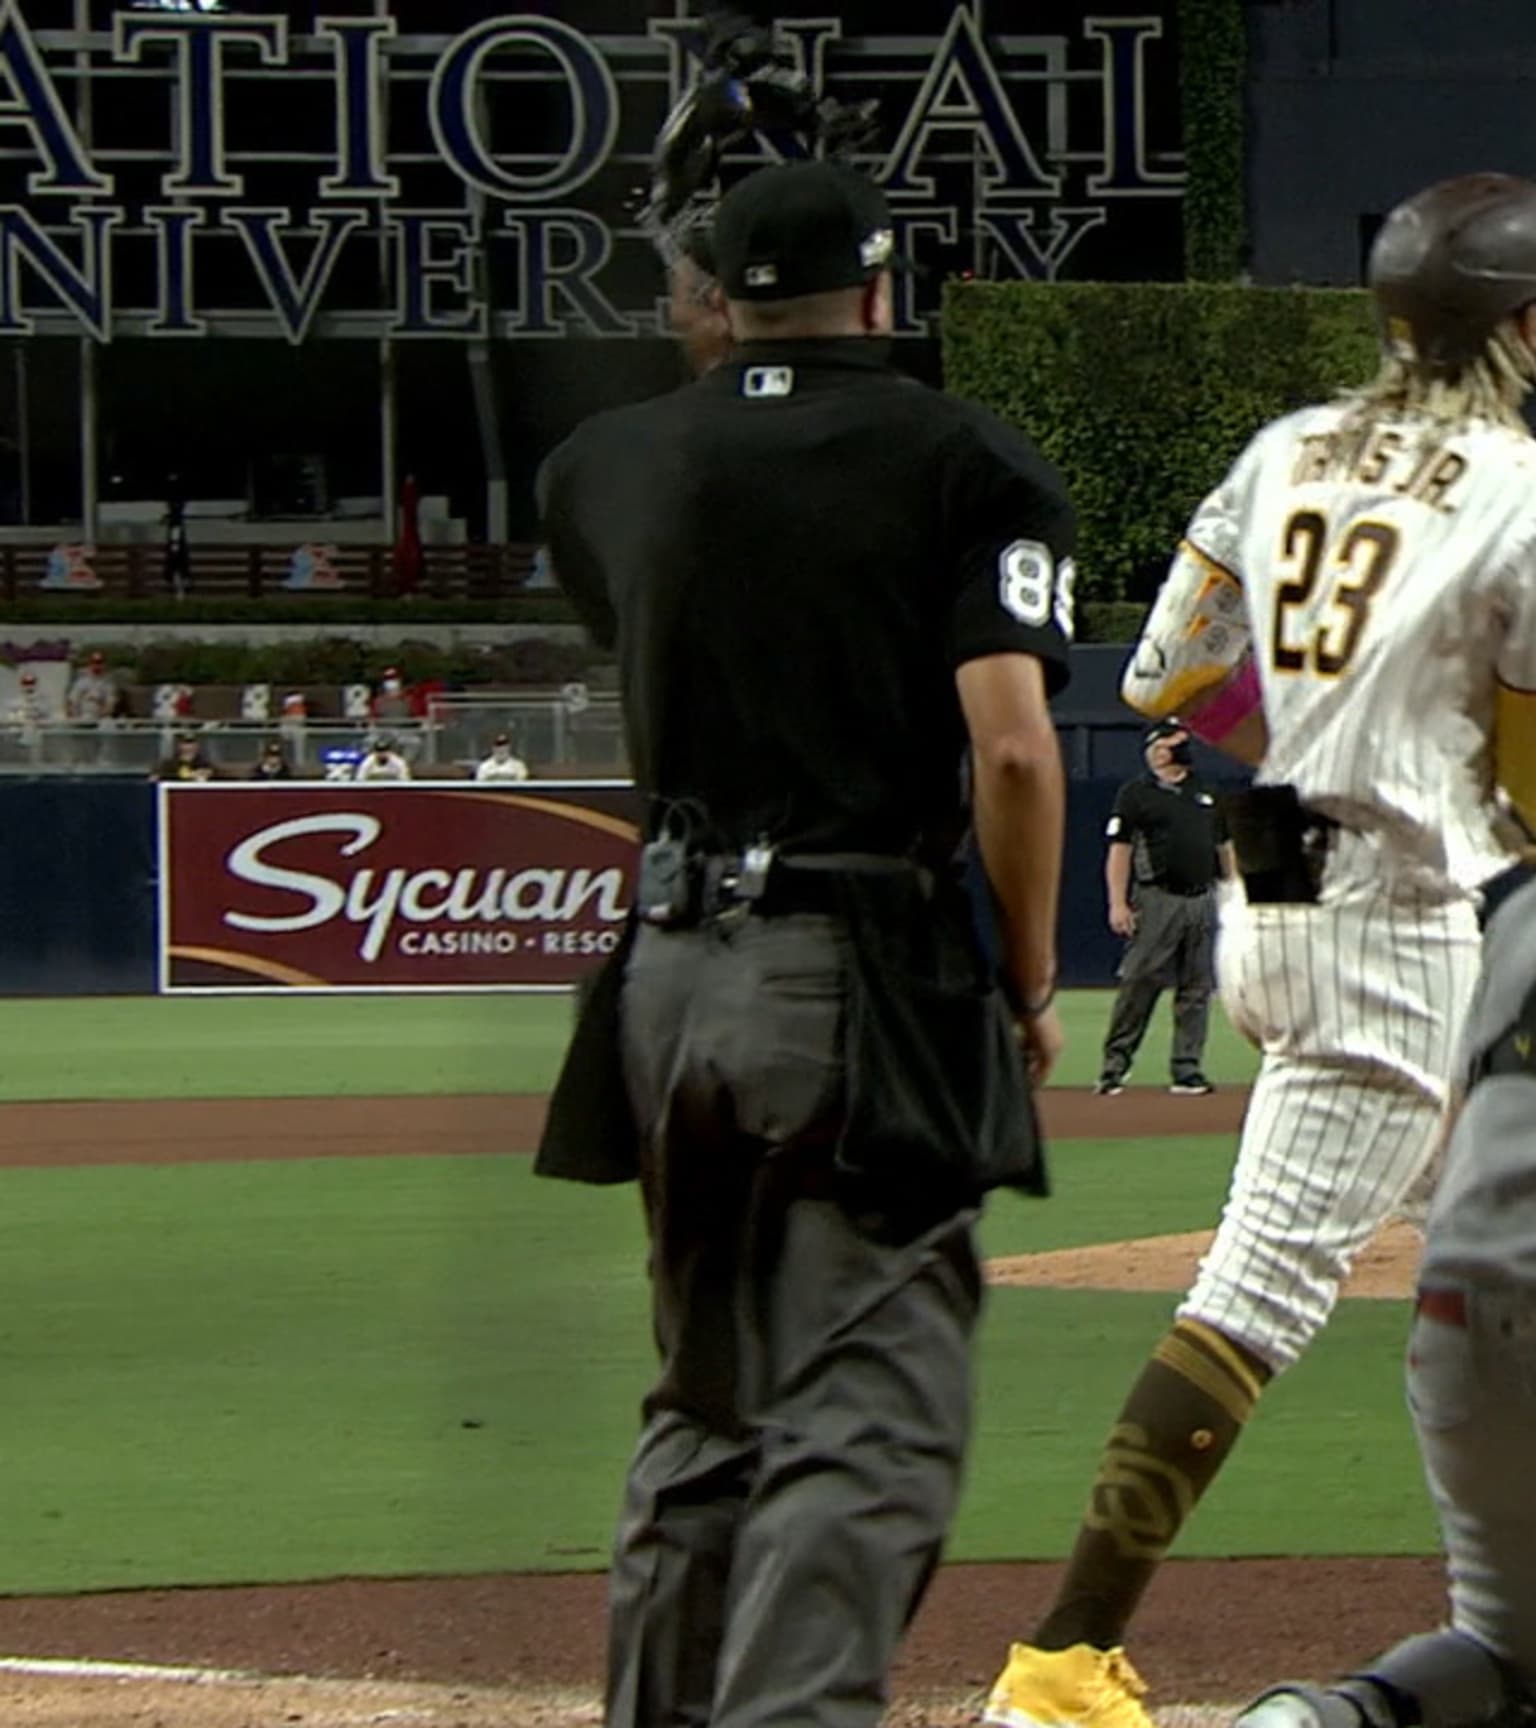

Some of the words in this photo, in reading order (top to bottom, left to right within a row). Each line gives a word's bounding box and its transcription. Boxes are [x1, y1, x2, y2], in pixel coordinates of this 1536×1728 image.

[1273, 507, 1402, 680] 23
[224, 813, 628, 962] Sycuan
[399, 931, 516, 955] CASINO
